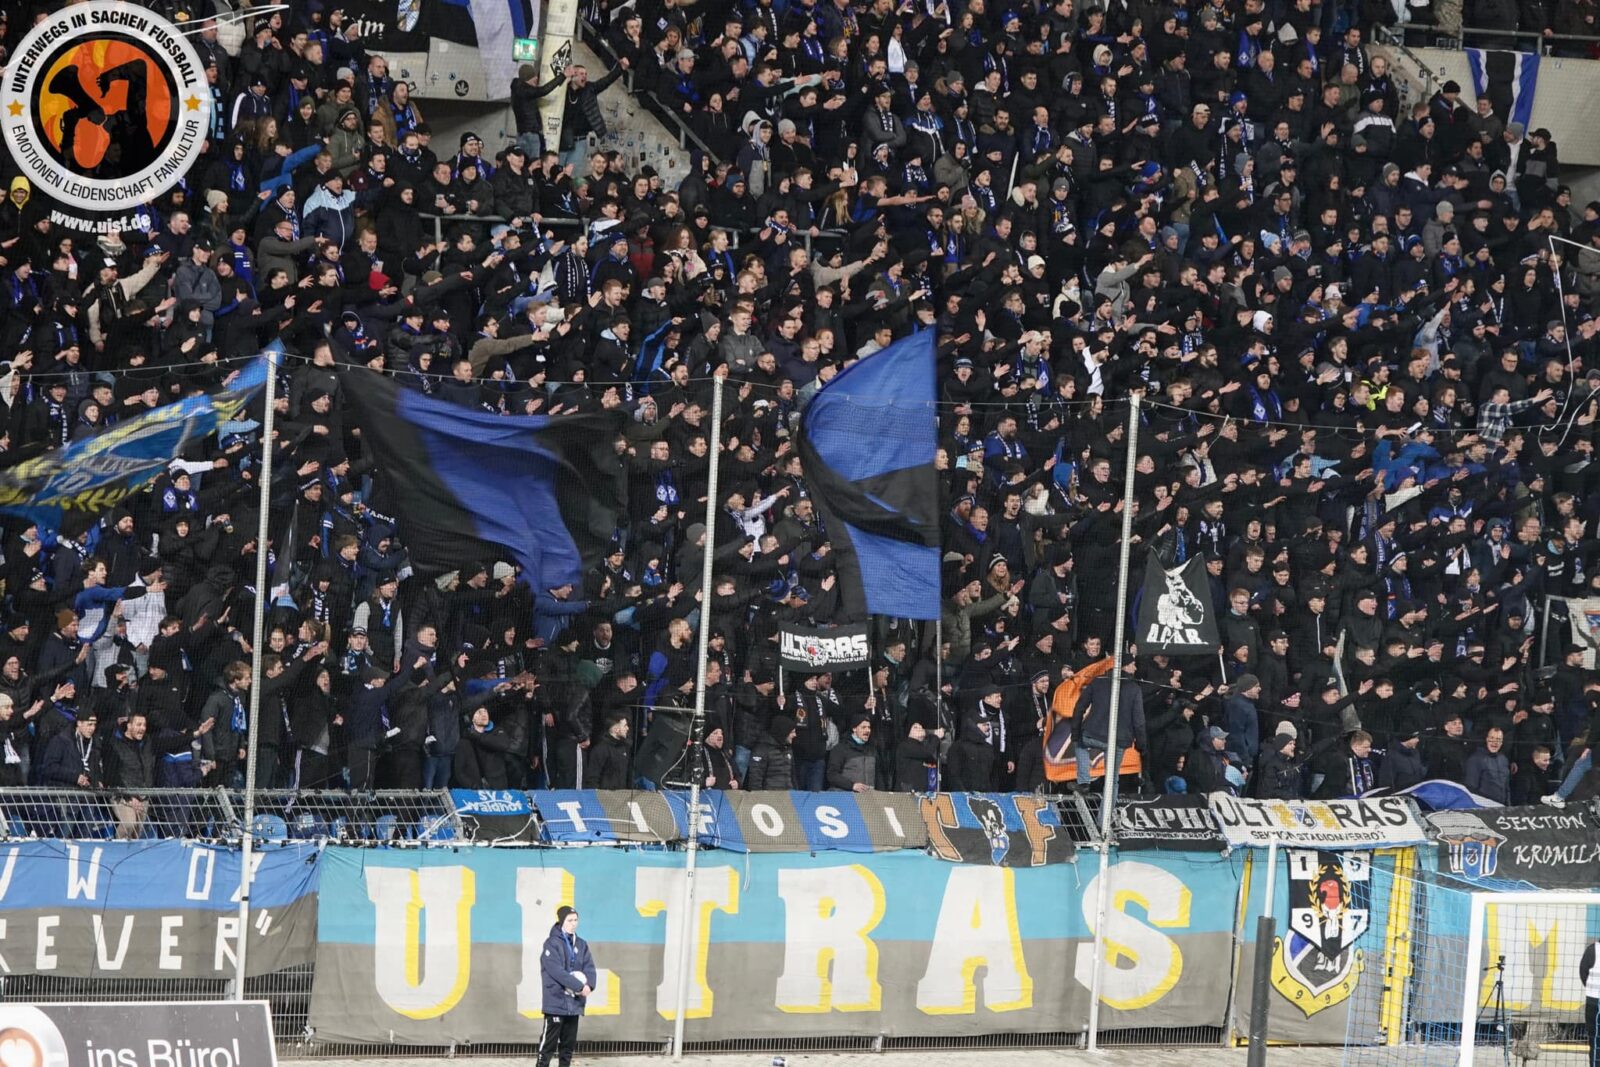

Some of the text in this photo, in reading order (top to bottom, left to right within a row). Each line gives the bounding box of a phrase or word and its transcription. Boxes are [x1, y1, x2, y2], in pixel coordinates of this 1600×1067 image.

[478, 789, 496, 802] SV
[1496, 813, 1587, 831] SEKTION
[364, 861, 1192, 1021] ULTRAS
[86, 1038, 240, 1067] ins Büro!
